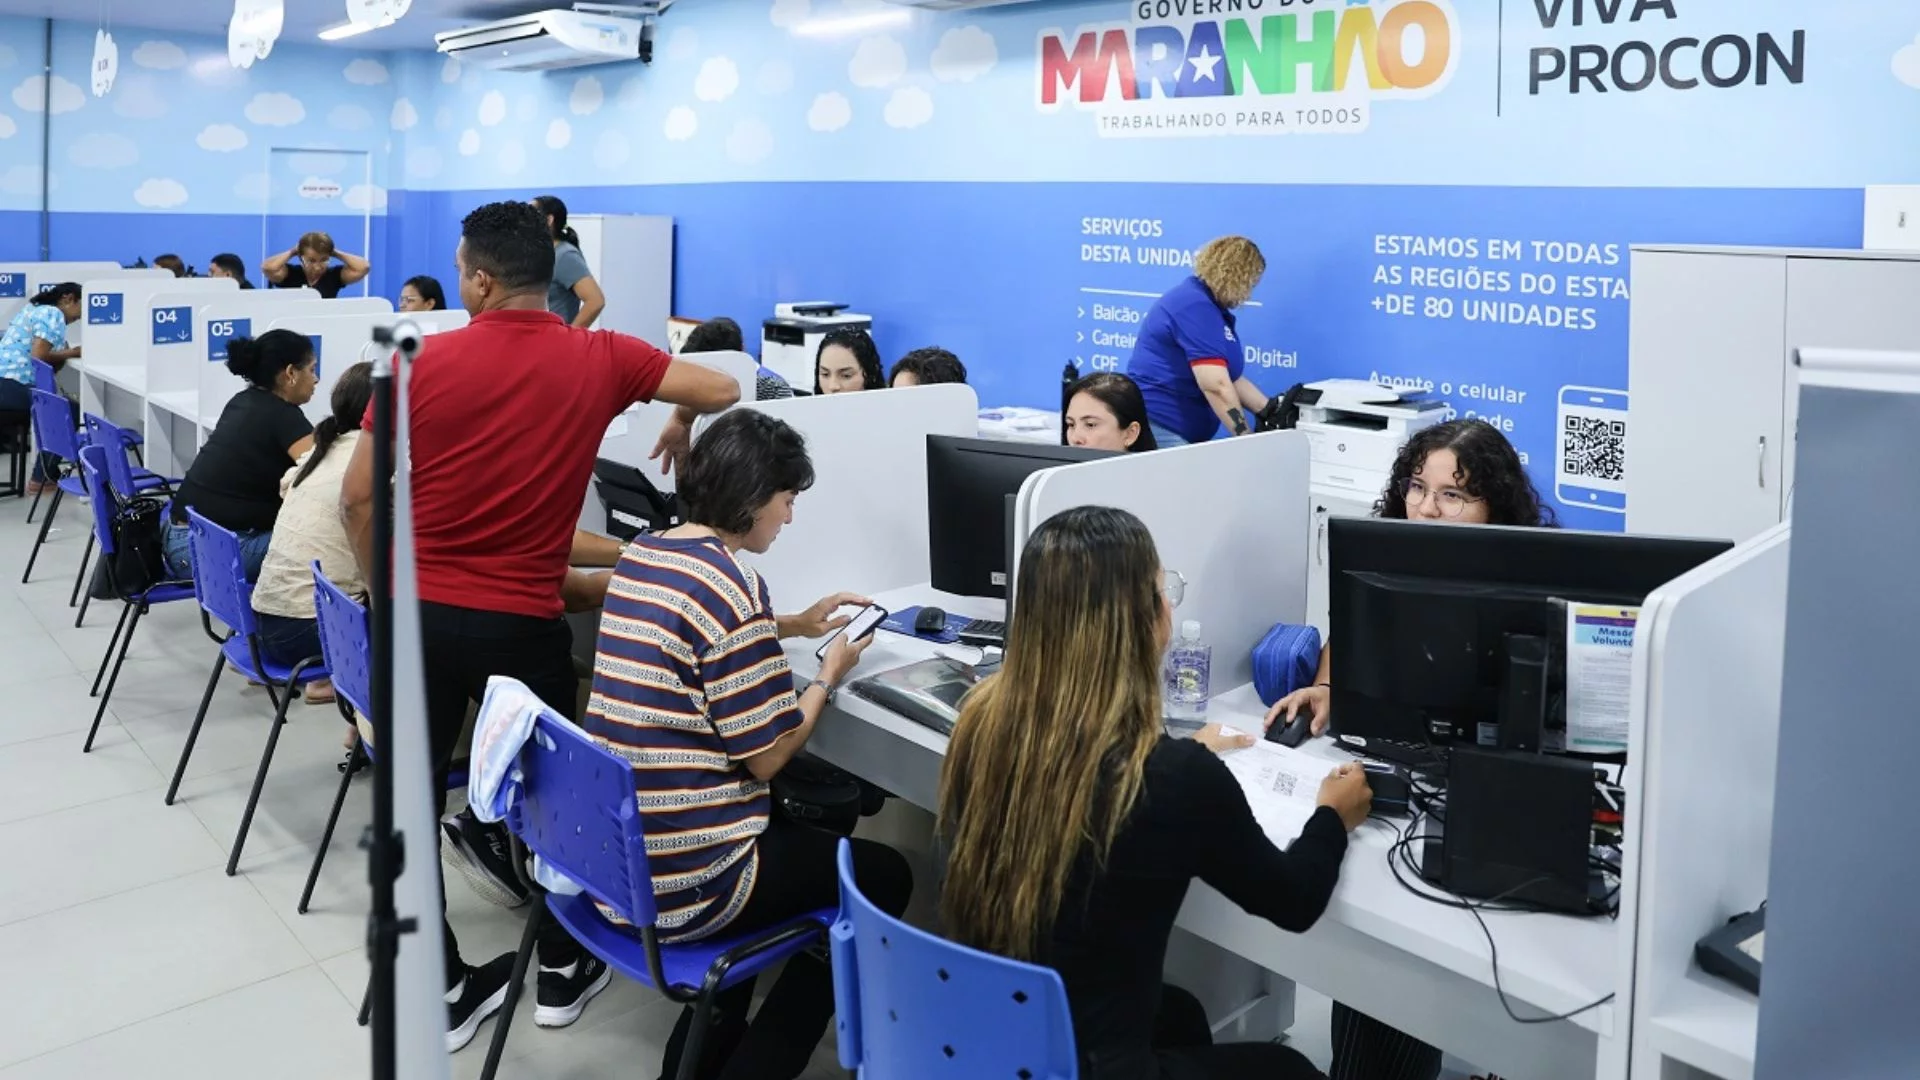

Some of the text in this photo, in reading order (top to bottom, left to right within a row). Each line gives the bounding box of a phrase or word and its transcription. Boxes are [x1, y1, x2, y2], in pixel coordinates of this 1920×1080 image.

[1529, 29, 1805, 95] PROCON
[1102, 107, 1362, 129] TRABALHANDO PARA TODOS
[1081, 217, 1163, 240] SERVIÇOS
[1081, 244, 1197, 268] DESTA UNIDA
[1375, 234, 1620, 266] ESTAMOS EM TODAS
[1373, 264, 1402, 285] AS
[1410, 266, 1511, 292] REGIÕES
[1520, 272, 1556, 295] DO
[91, 295, 109, 307] 03
[1371, 293, 1597, 331] +DE 80 UNIDADES
[155, 310, 178, 323] 04
[1093, 304, 1140, 324] Balcão
[211, 322, 234, 336] 05
[1091, 354, 1119, 372] CPF
[1244, 346, 1297, 369] Digital
[1440, 383, 1453, 396] o
[1459, 383, 1527, 404] celular
